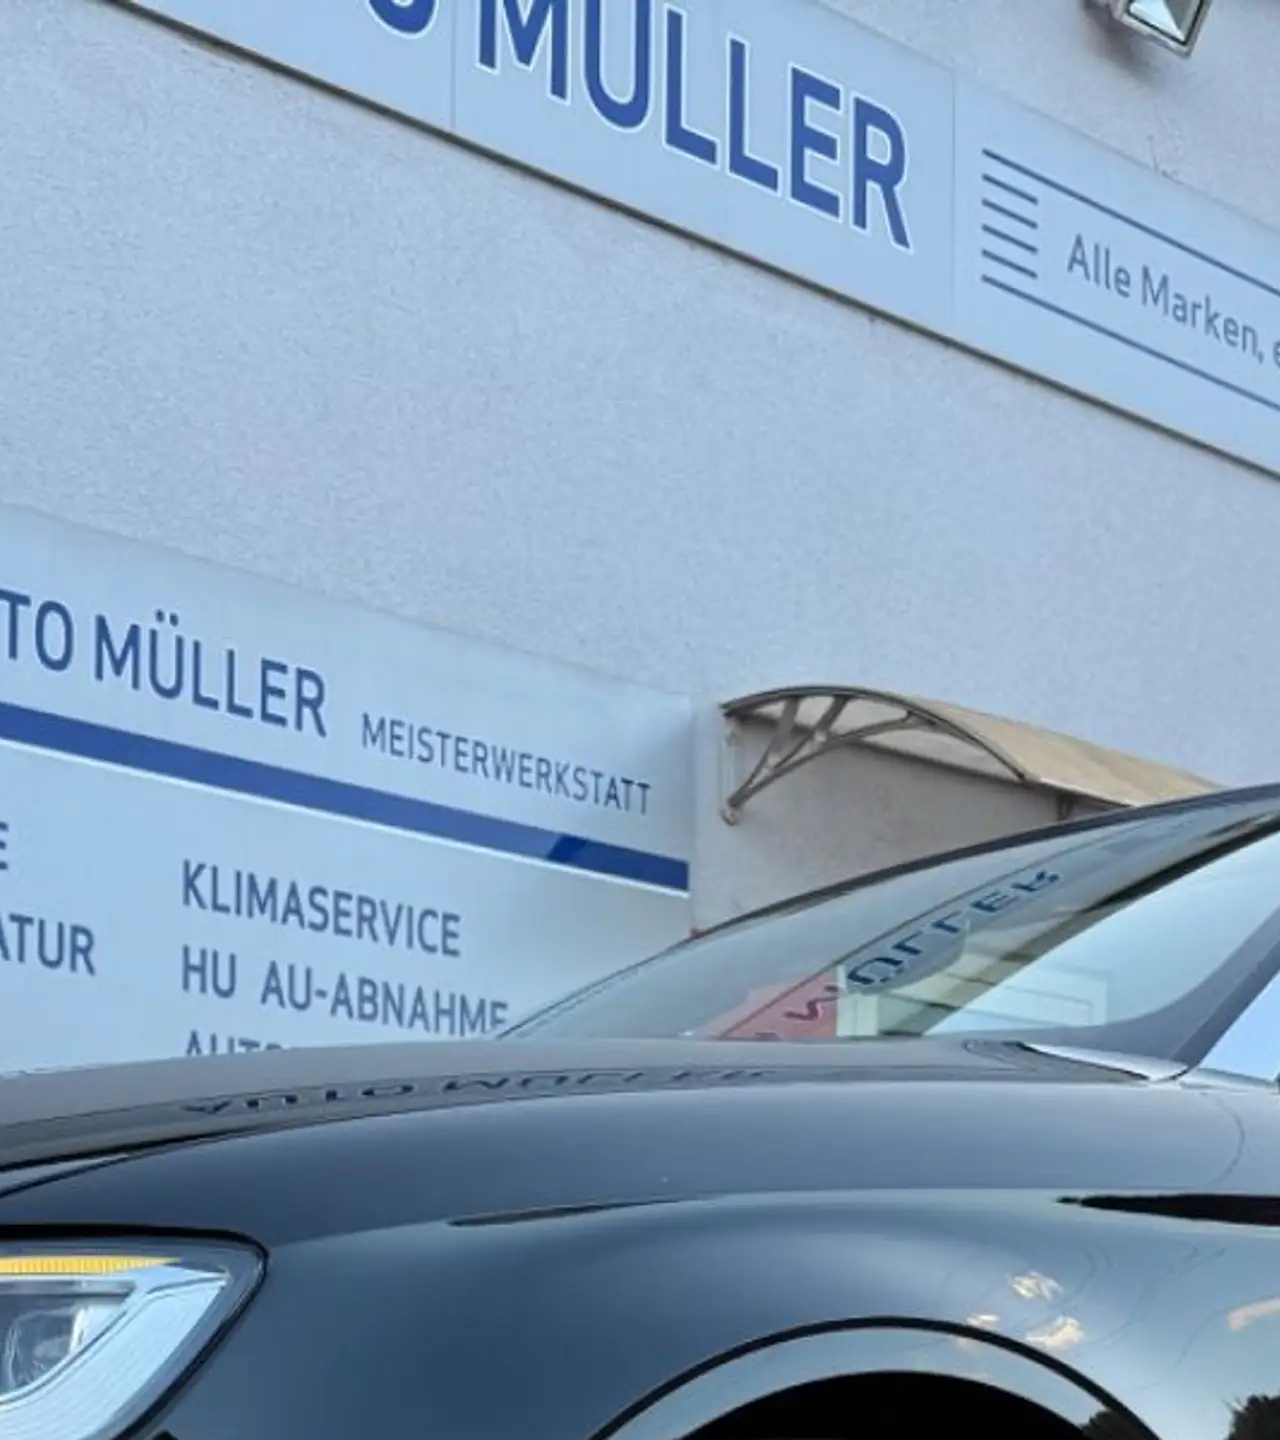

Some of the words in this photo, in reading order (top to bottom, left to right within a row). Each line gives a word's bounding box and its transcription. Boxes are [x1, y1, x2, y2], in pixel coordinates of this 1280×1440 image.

[1066, 232, 1131, 299] Alle
[1140, 264, 1265, 364] Marken,
[94, 609, 328, 738] MÜLLER
[361, 712, 652, 815] MEISTERWERKSTATT
[182, 859, 462, 958] KLIMASERVICE
[182, 944, 238, 999] HU
[260, 960, 509, 1037] AU-ABNAHME
